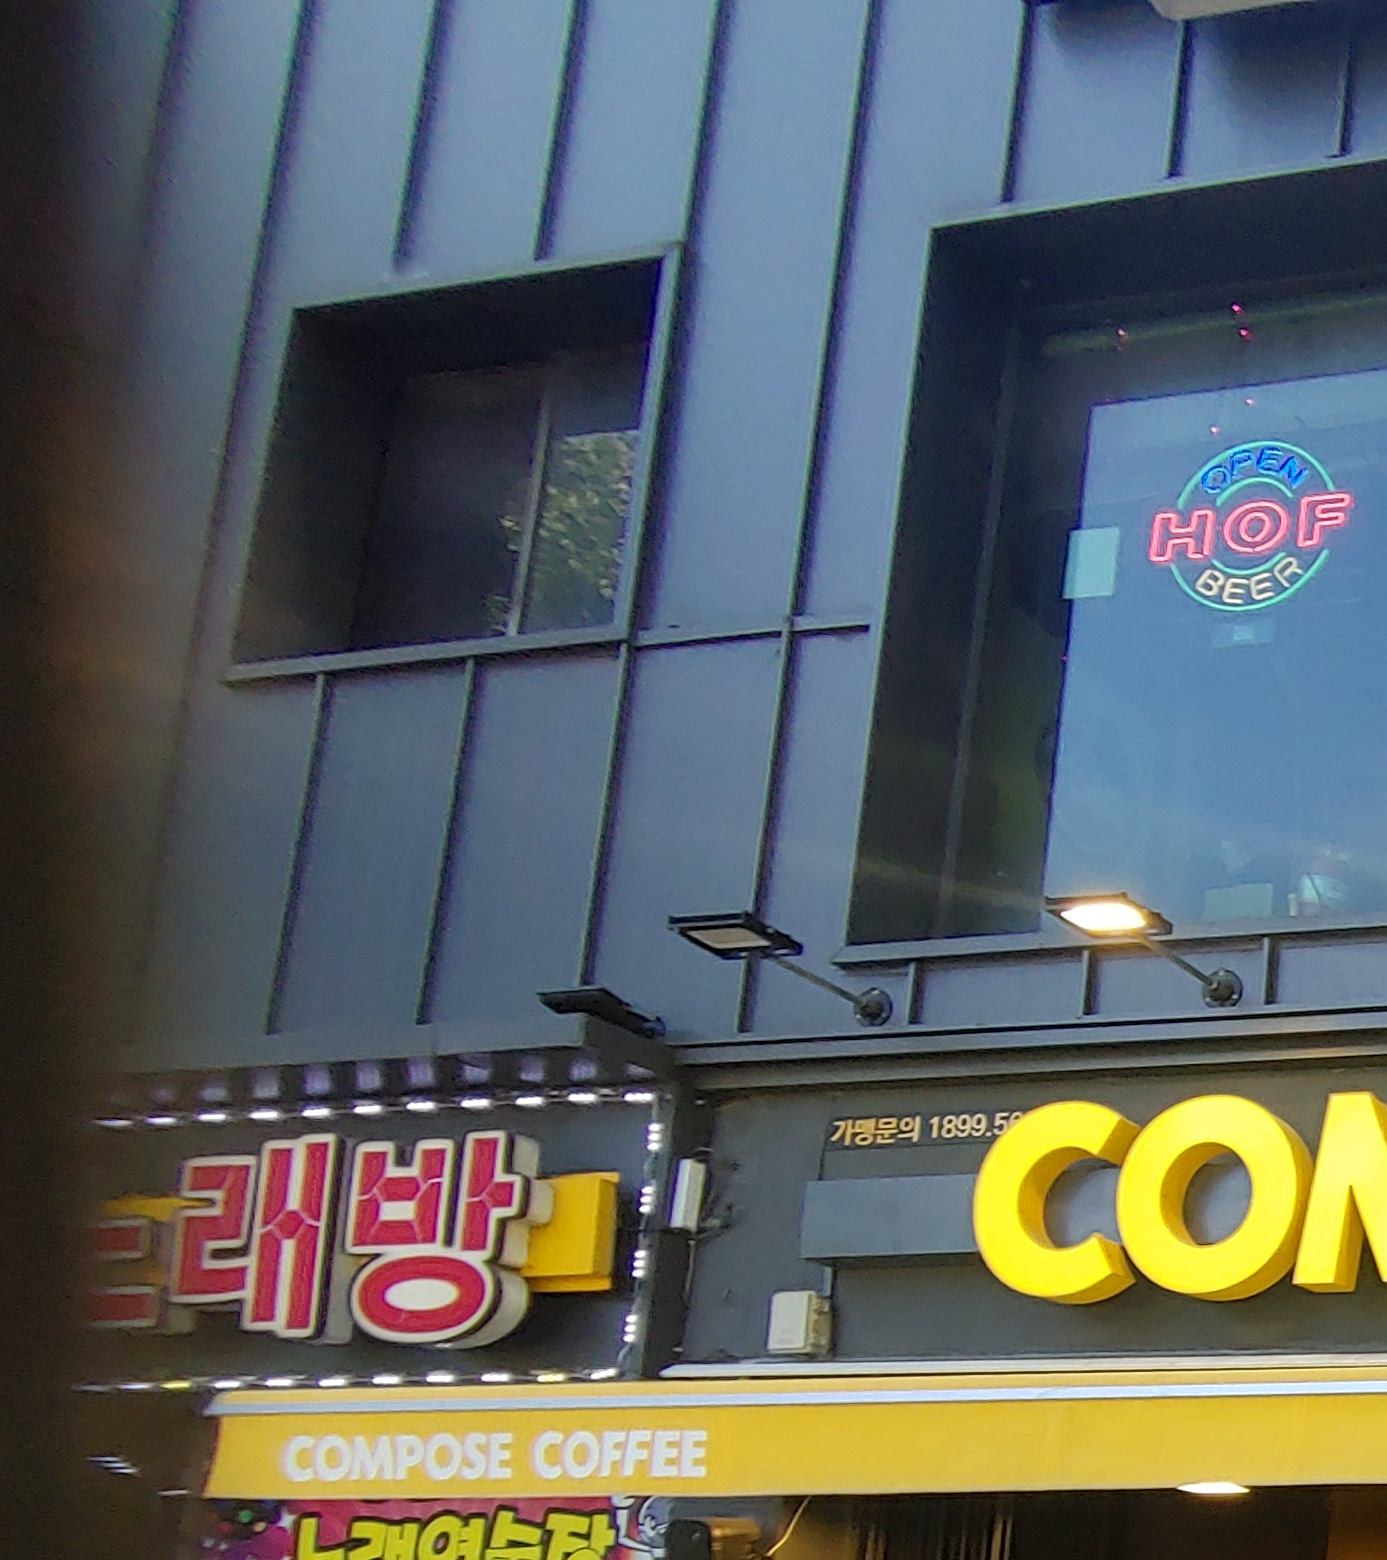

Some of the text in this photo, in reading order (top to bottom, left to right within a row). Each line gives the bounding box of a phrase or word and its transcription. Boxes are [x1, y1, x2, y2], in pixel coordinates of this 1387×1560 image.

[1201, 447, 1309, 495] OPEN
[1149, 492, 1353, 564] HOF
[1195, 555, 1304, 604] BEER
[830, 1115, 922, 1146] 가맹문의
[85, 1130, 530, 1345] 래방
[282, 1429, 708, 1483] COMPOSE COFFEE
